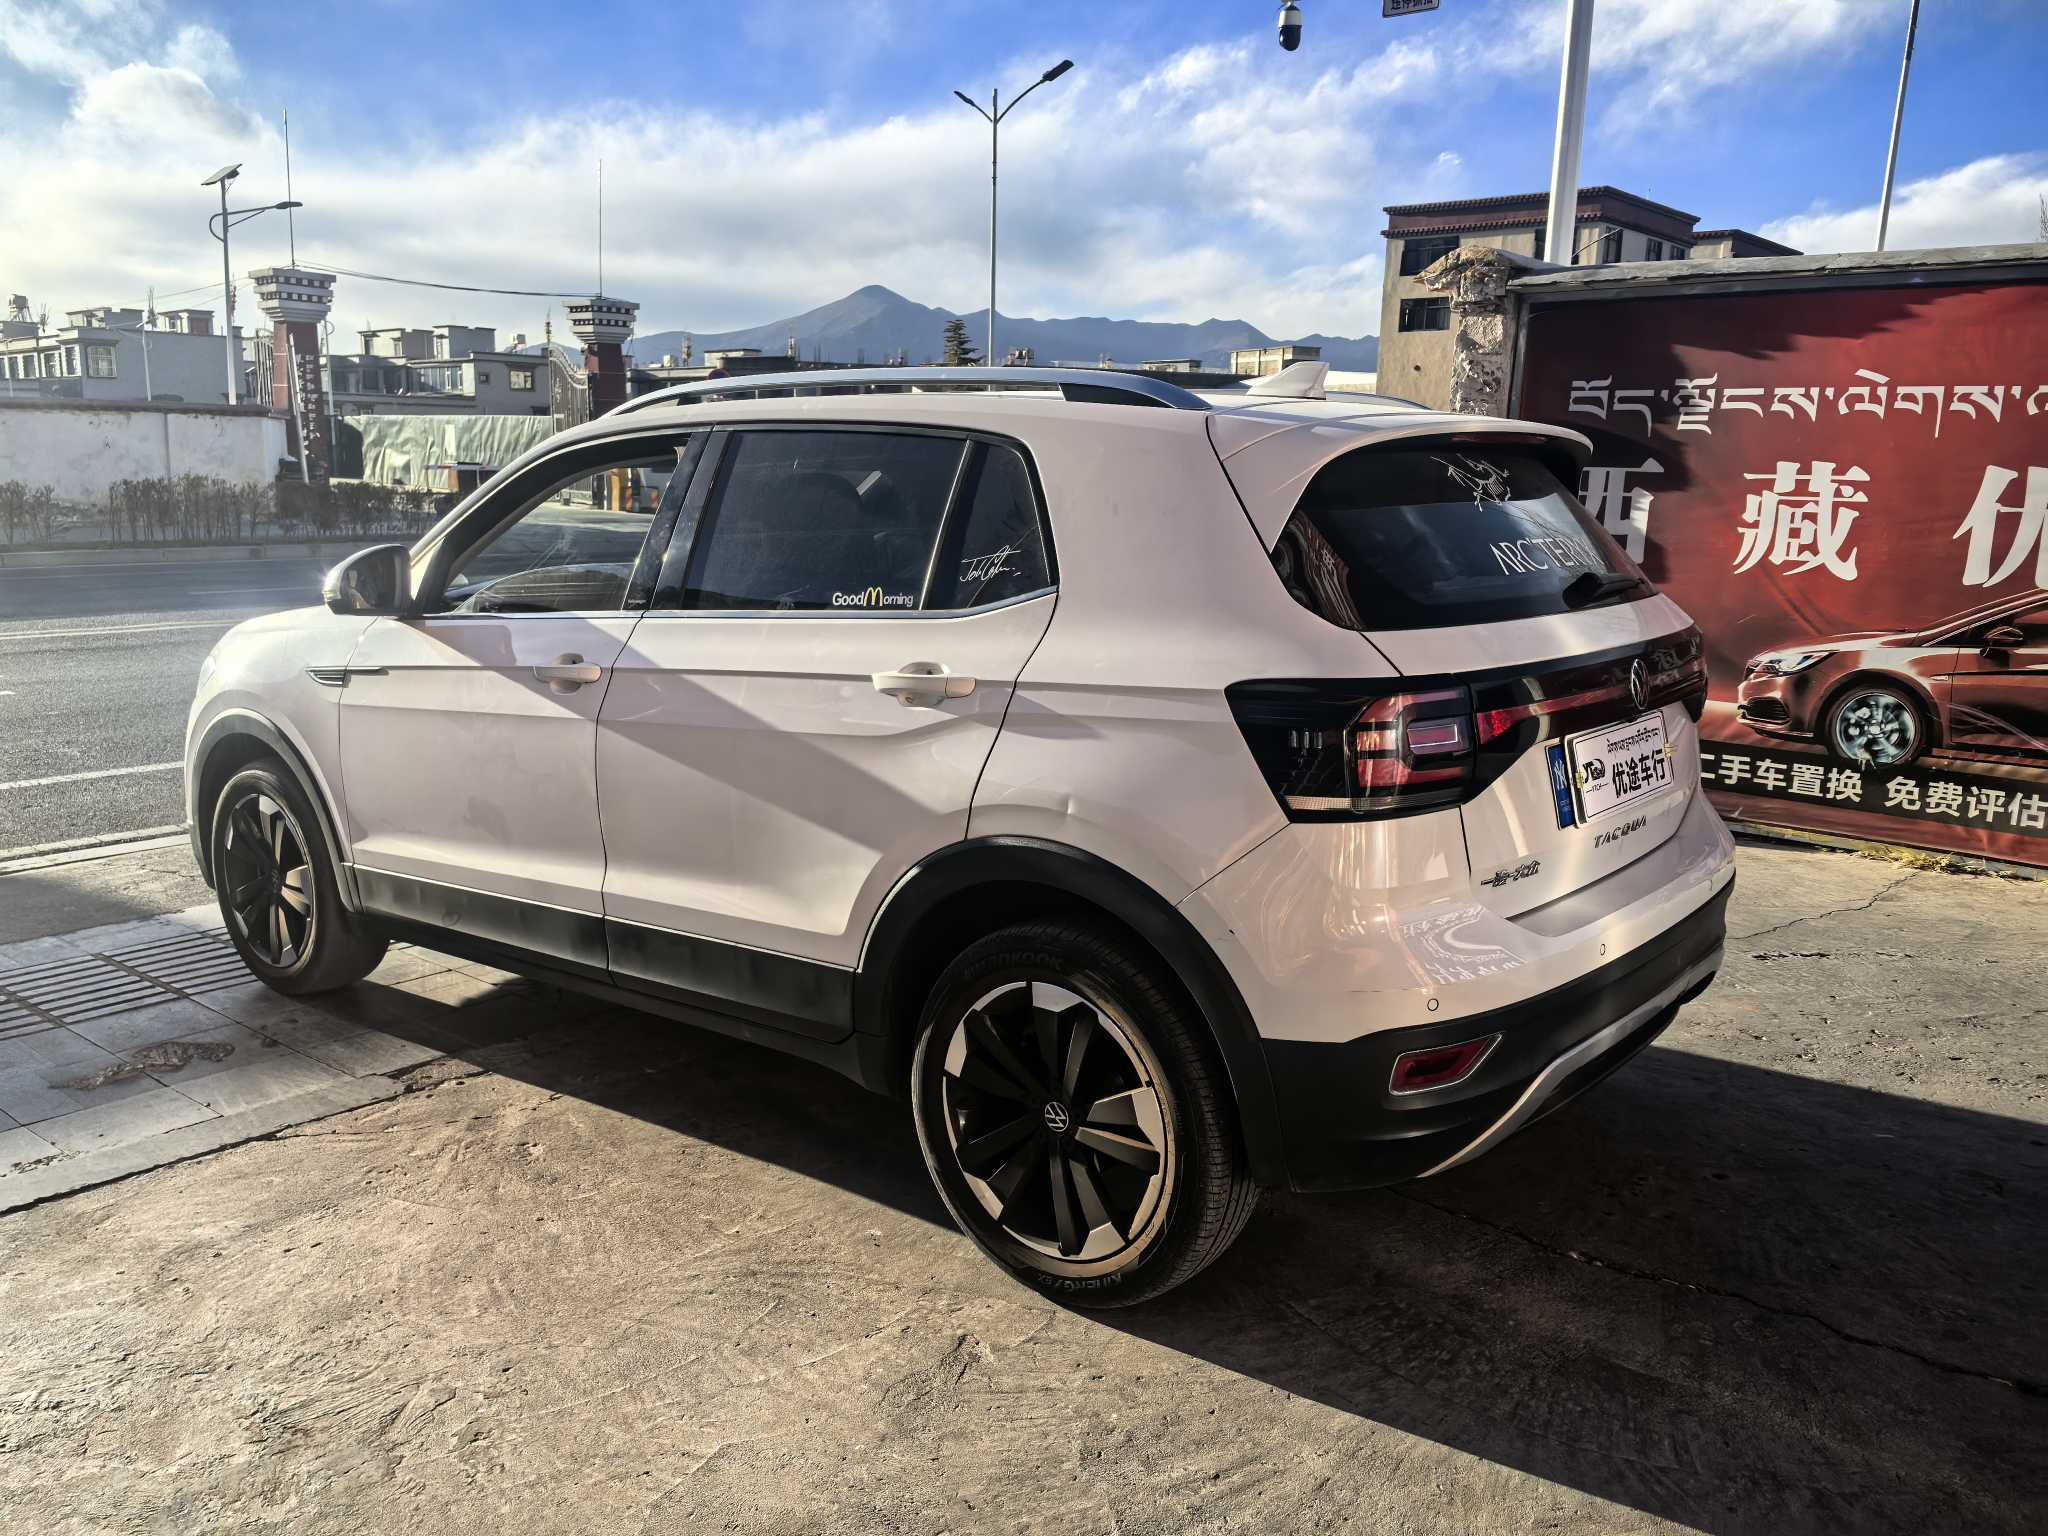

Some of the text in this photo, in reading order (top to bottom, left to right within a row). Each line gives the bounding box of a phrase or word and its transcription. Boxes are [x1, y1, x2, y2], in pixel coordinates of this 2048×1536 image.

[1612, 749, 1665, 798] 优途车行
[1884, 776, 2048, 830] 免费评估
